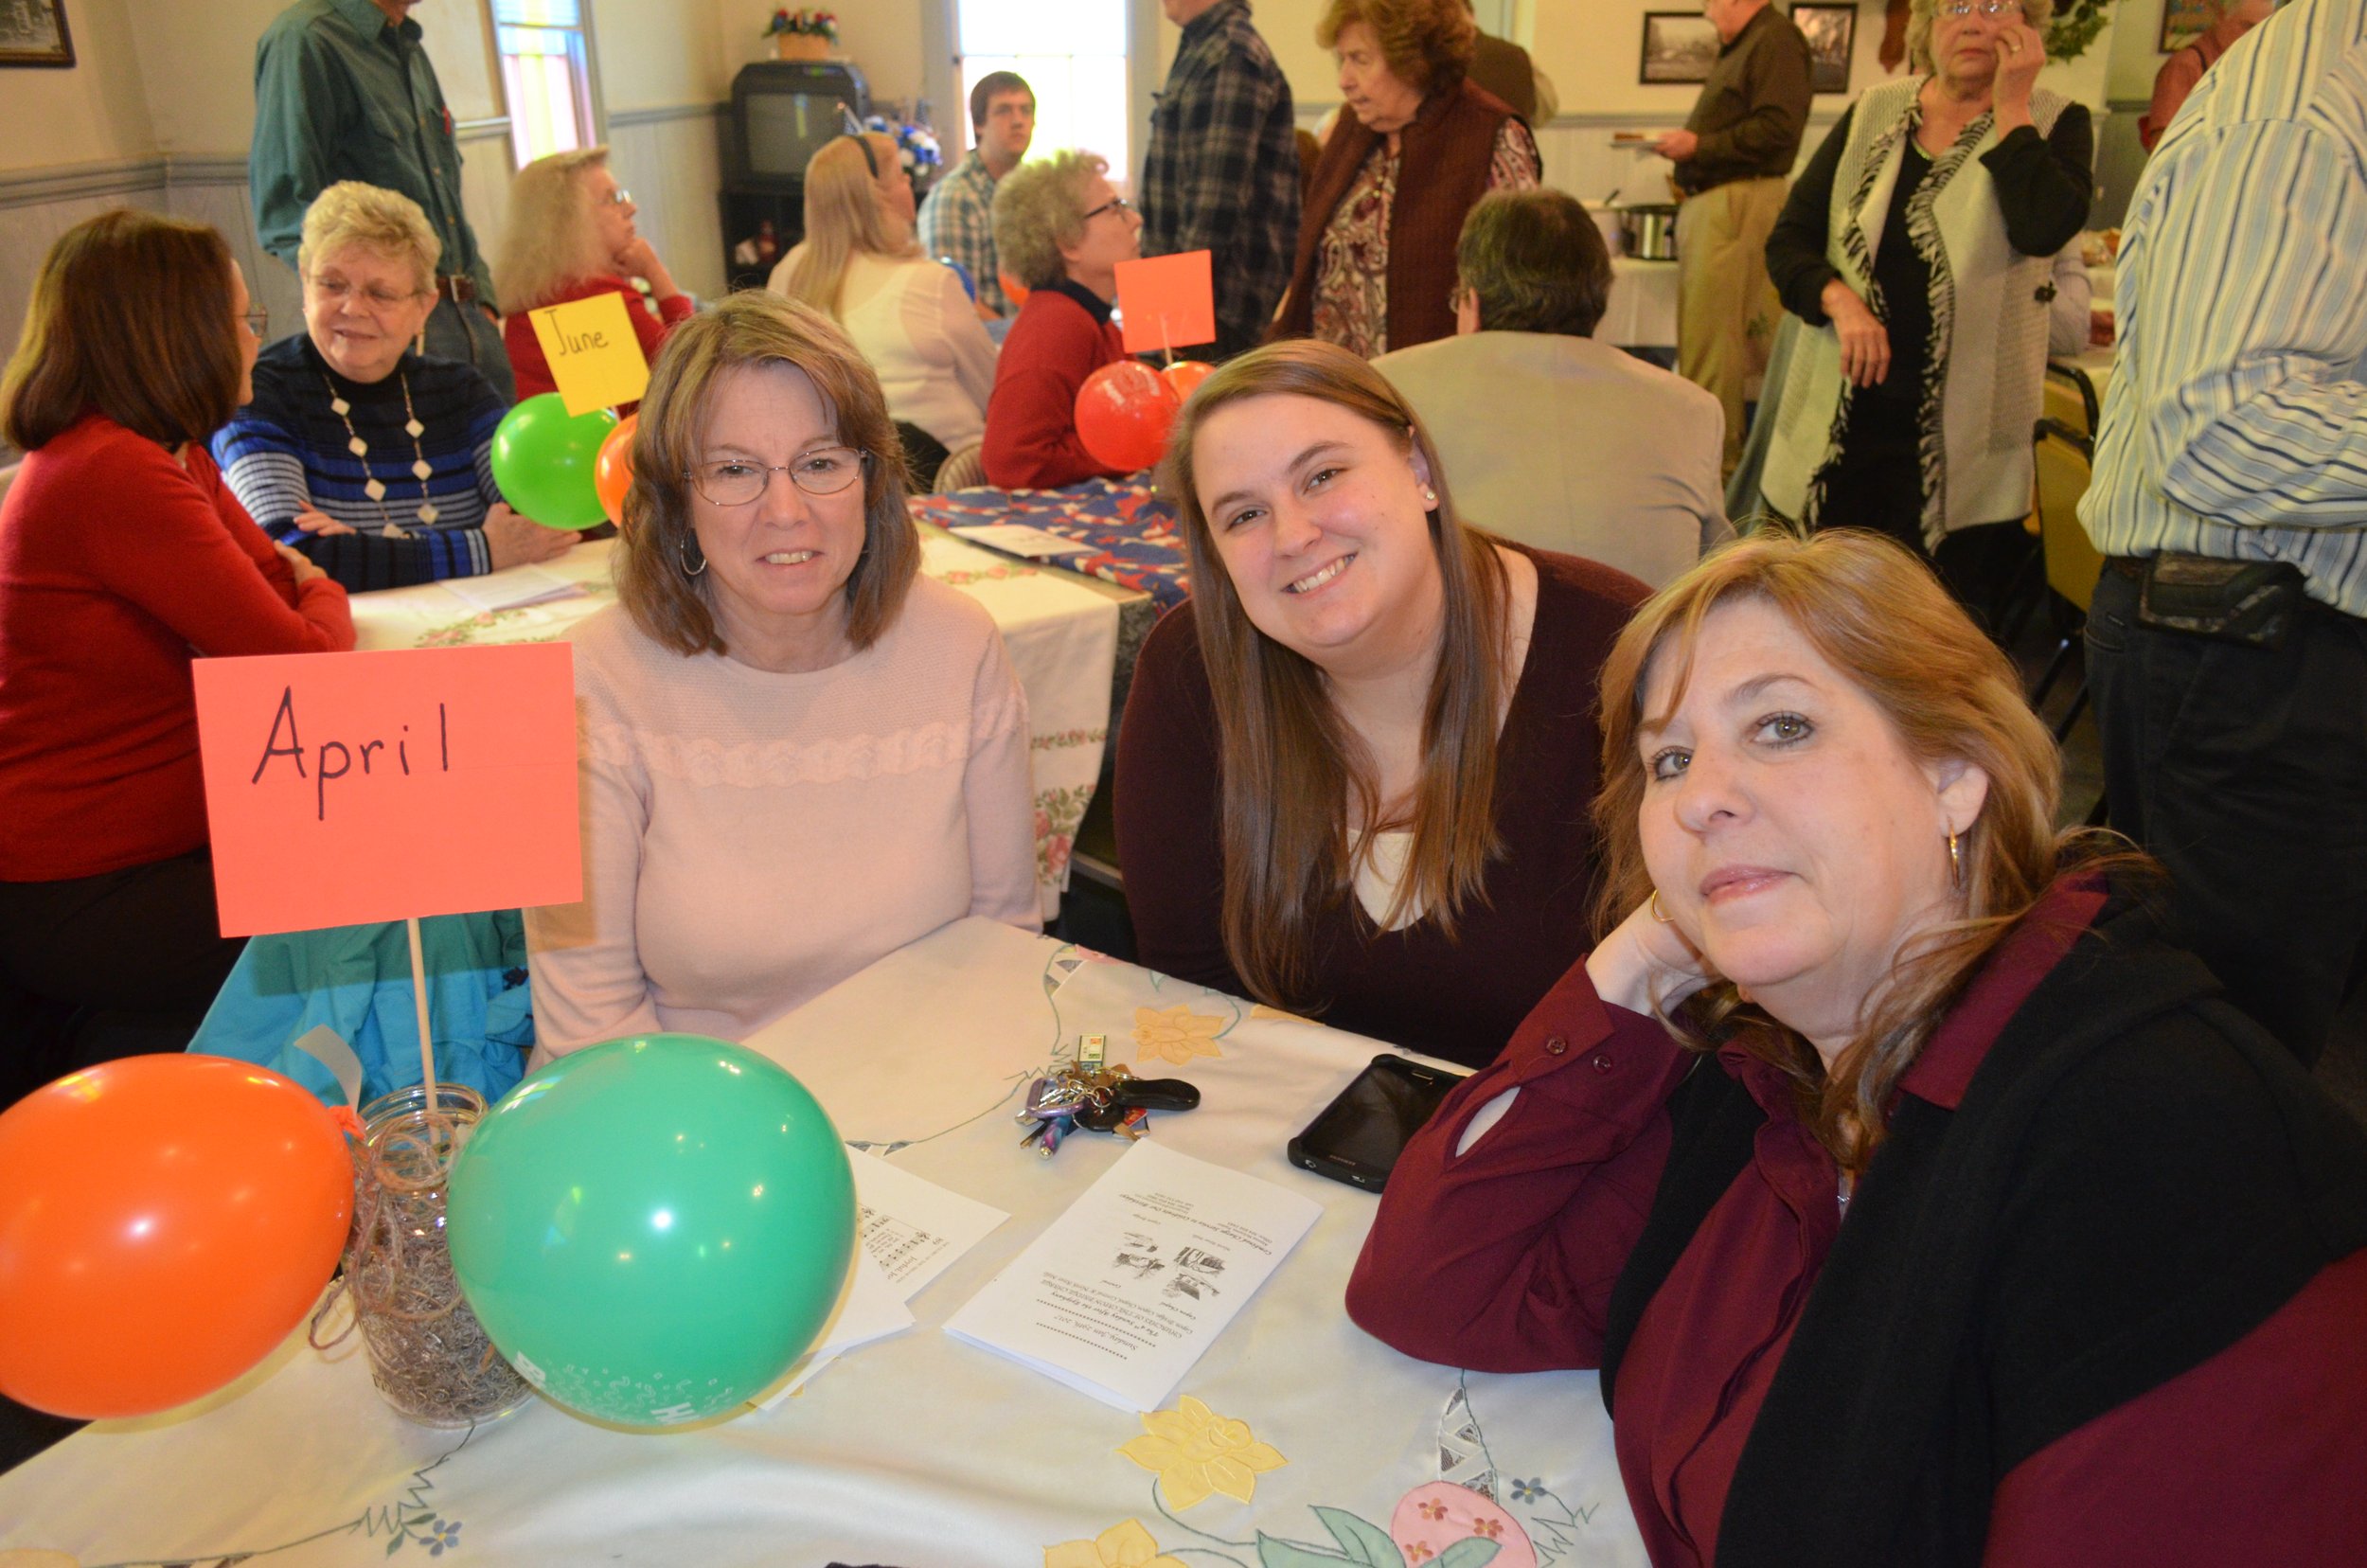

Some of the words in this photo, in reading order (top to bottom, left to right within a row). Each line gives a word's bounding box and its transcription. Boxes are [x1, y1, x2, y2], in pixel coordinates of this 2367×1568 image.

[543, 308, 609, 356] June
[252, 685, 448, 821] April
[1196, 1220, 1220, 1232] Service
[1239, 1238, 1272, 1256] Combined
[1050, 1288, 1082, 1306] Epiphany
[1093, 1307, 1111, 1316] After
[1110, 1312, 1136, 1327] Sunday
